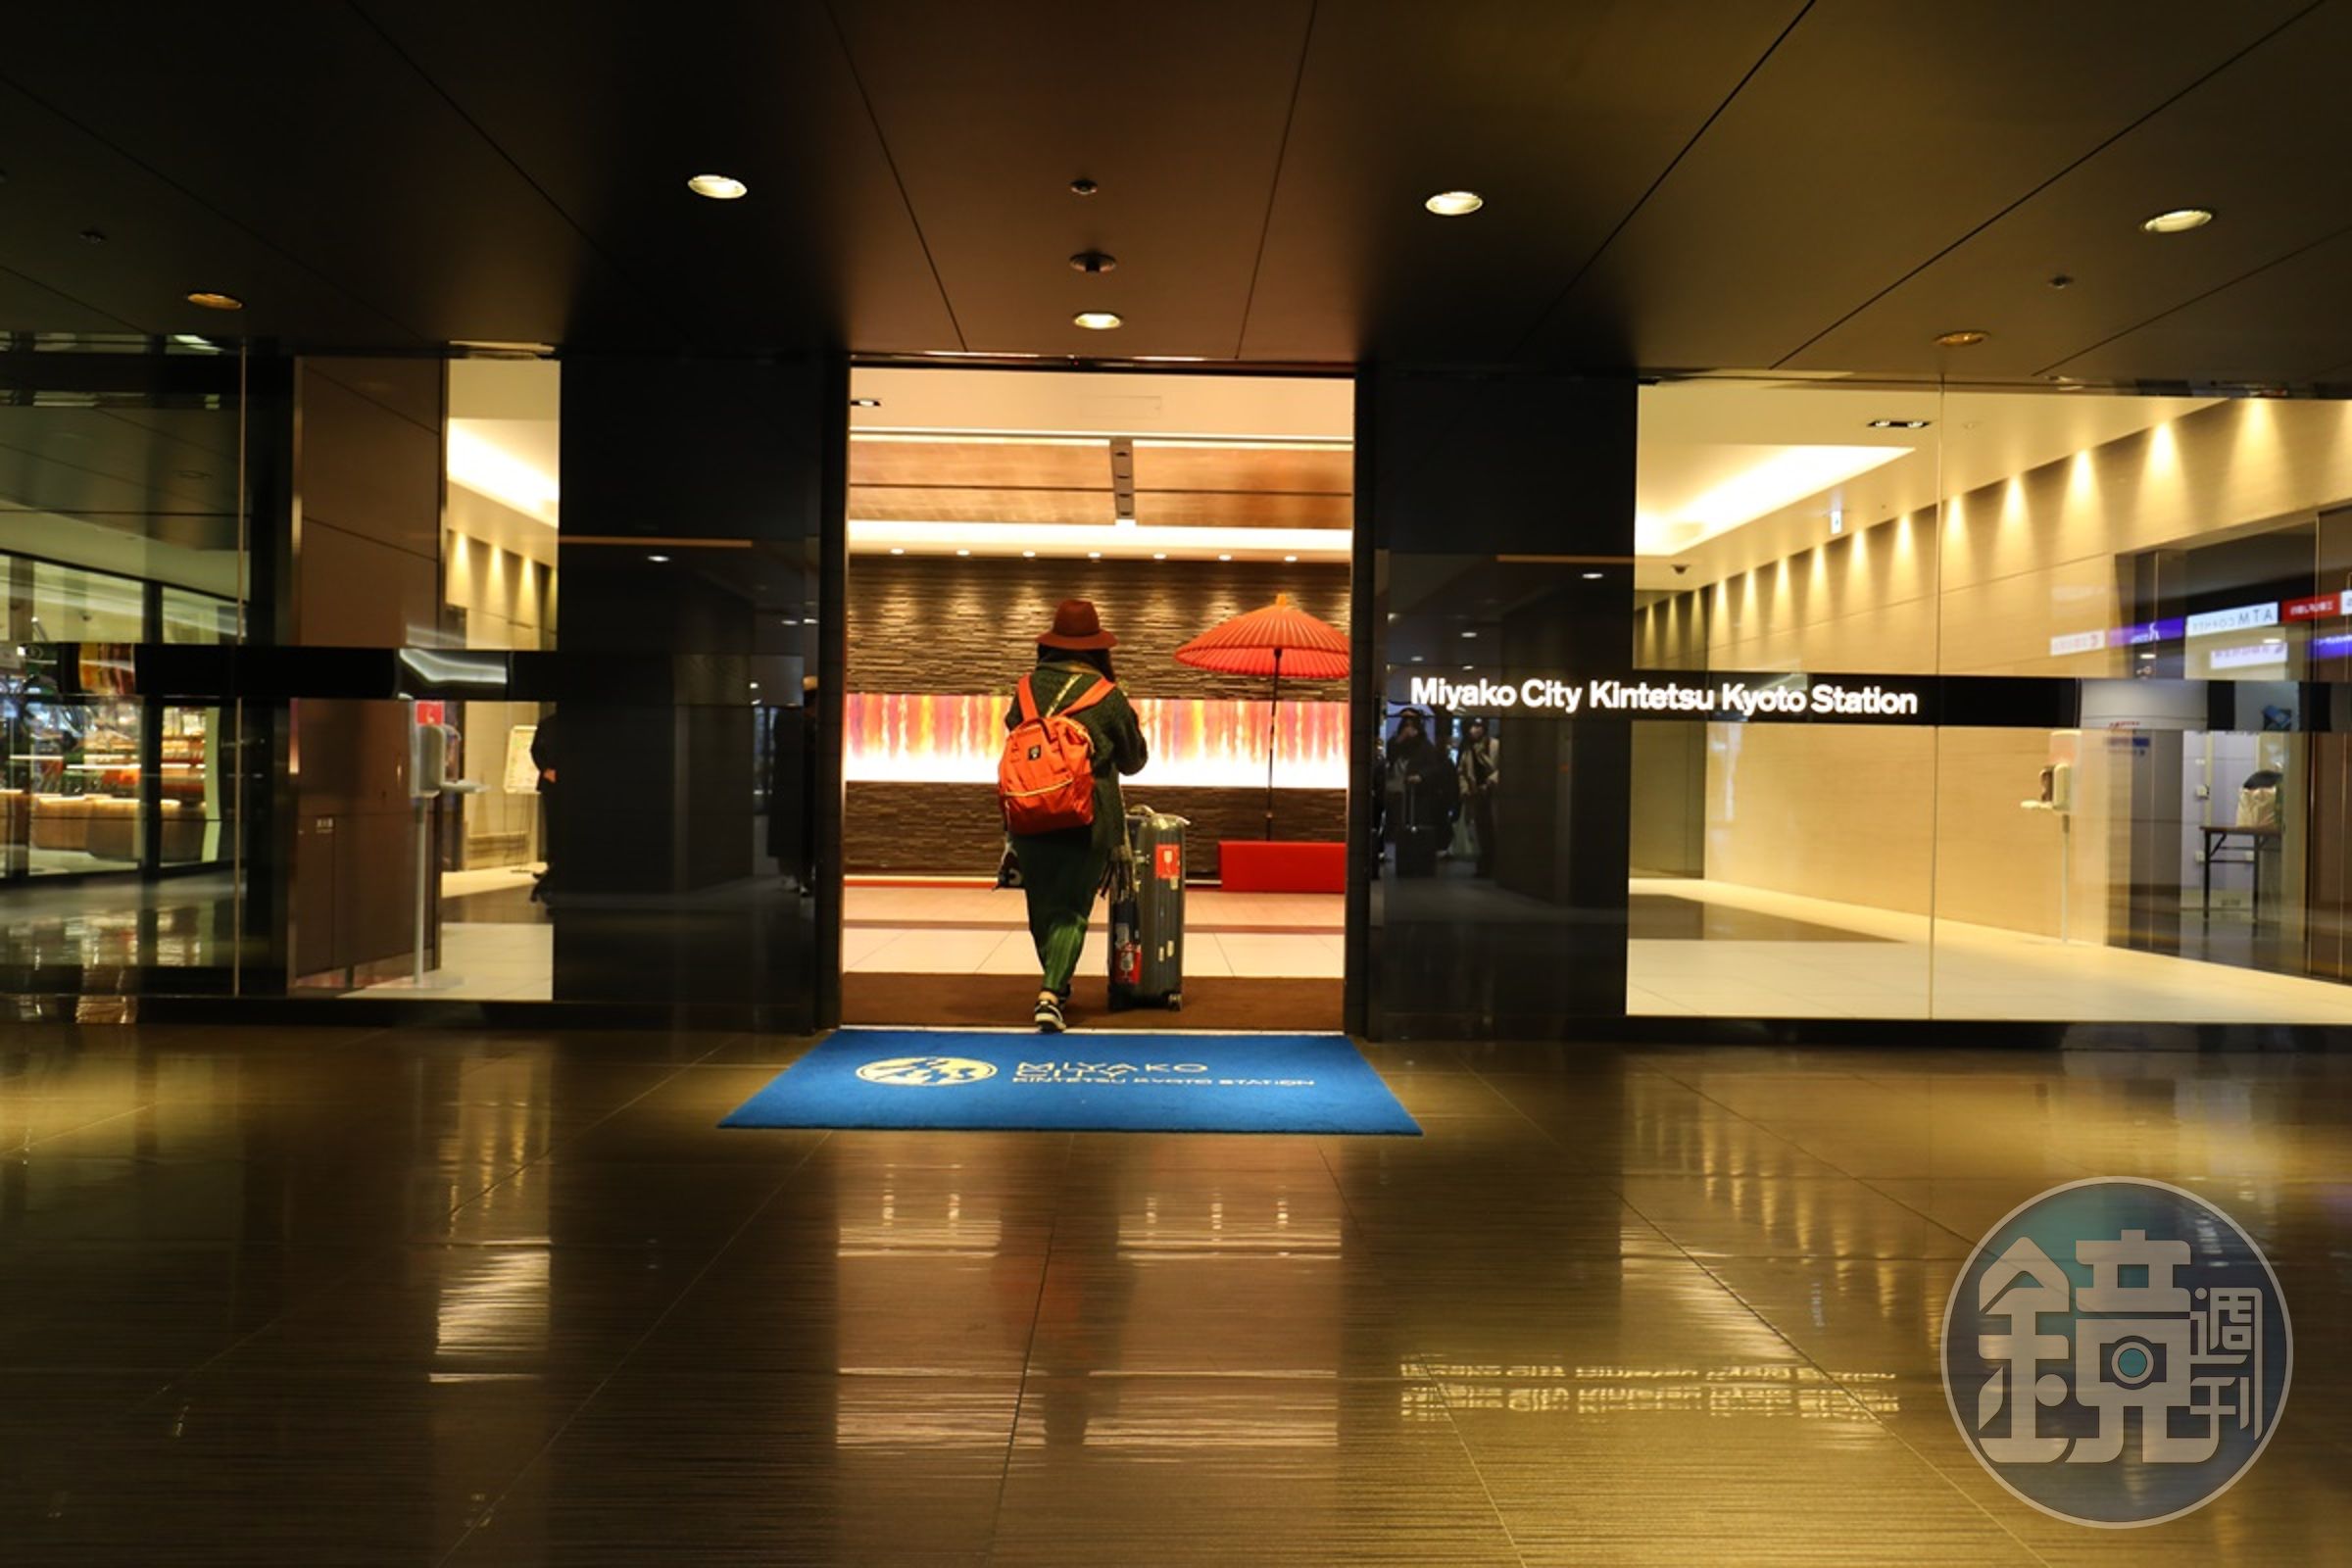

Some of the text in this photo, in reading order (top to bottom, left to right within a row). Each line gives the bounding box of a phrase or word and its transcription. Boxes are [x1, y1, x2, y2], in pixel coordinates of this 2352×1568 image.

[1410, 677, 1918, 716] Miyako City Kintetsu Kyoto Station
[1016, 1061, 1209, 1074] MIYAKO
